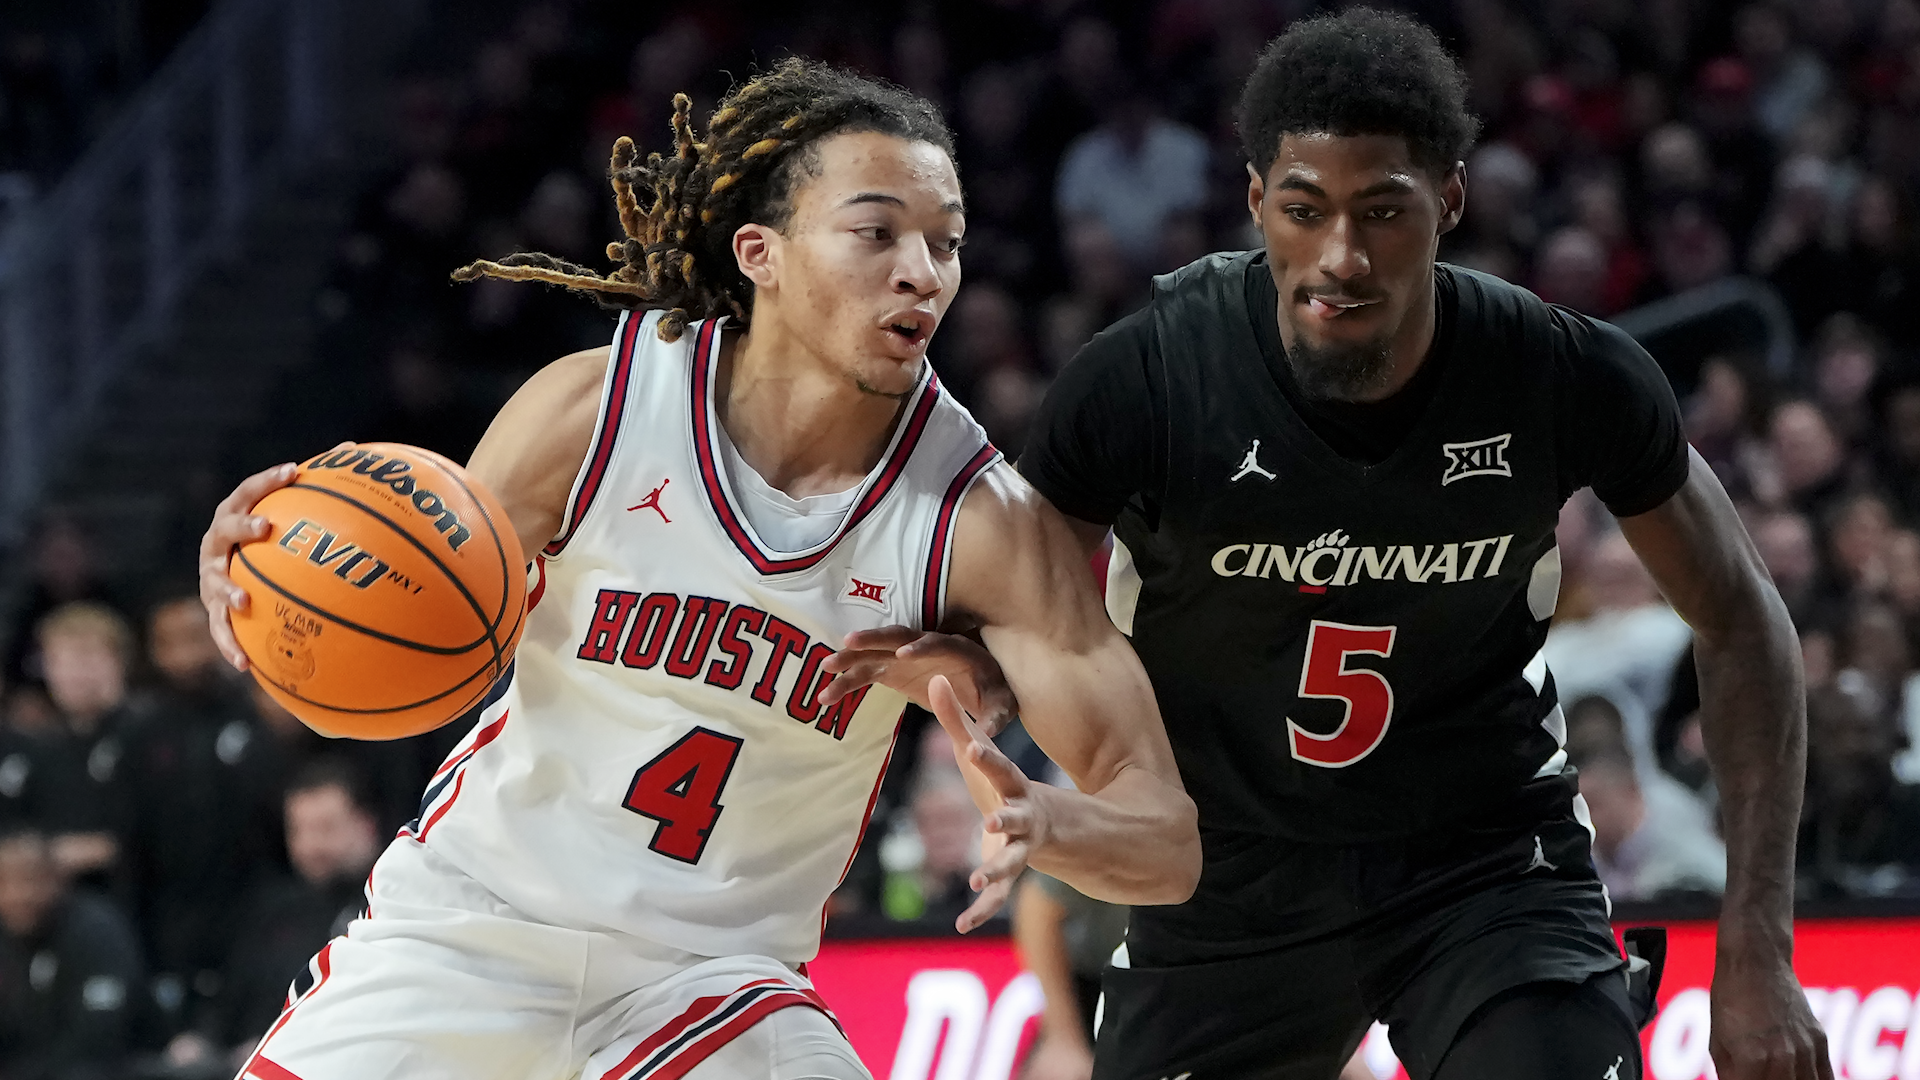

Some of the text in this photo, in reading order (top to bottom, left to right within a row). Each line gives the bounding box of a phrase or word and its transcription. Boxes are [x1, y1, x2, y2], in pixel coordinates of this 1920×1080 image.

[307, 449, 471, 551] Wilson
[1442, 433, 1512, 486] XII
[278, 517, 424, 595] EVO NXT
[848, 577, 886, 604] XII
[1211, 532, 1514, 587] CINCINNATI
[577, 588, 874, 741] HOUSTON
[1286, 620, 1397, 768] 5
[621, 726, 744, 865] 4
